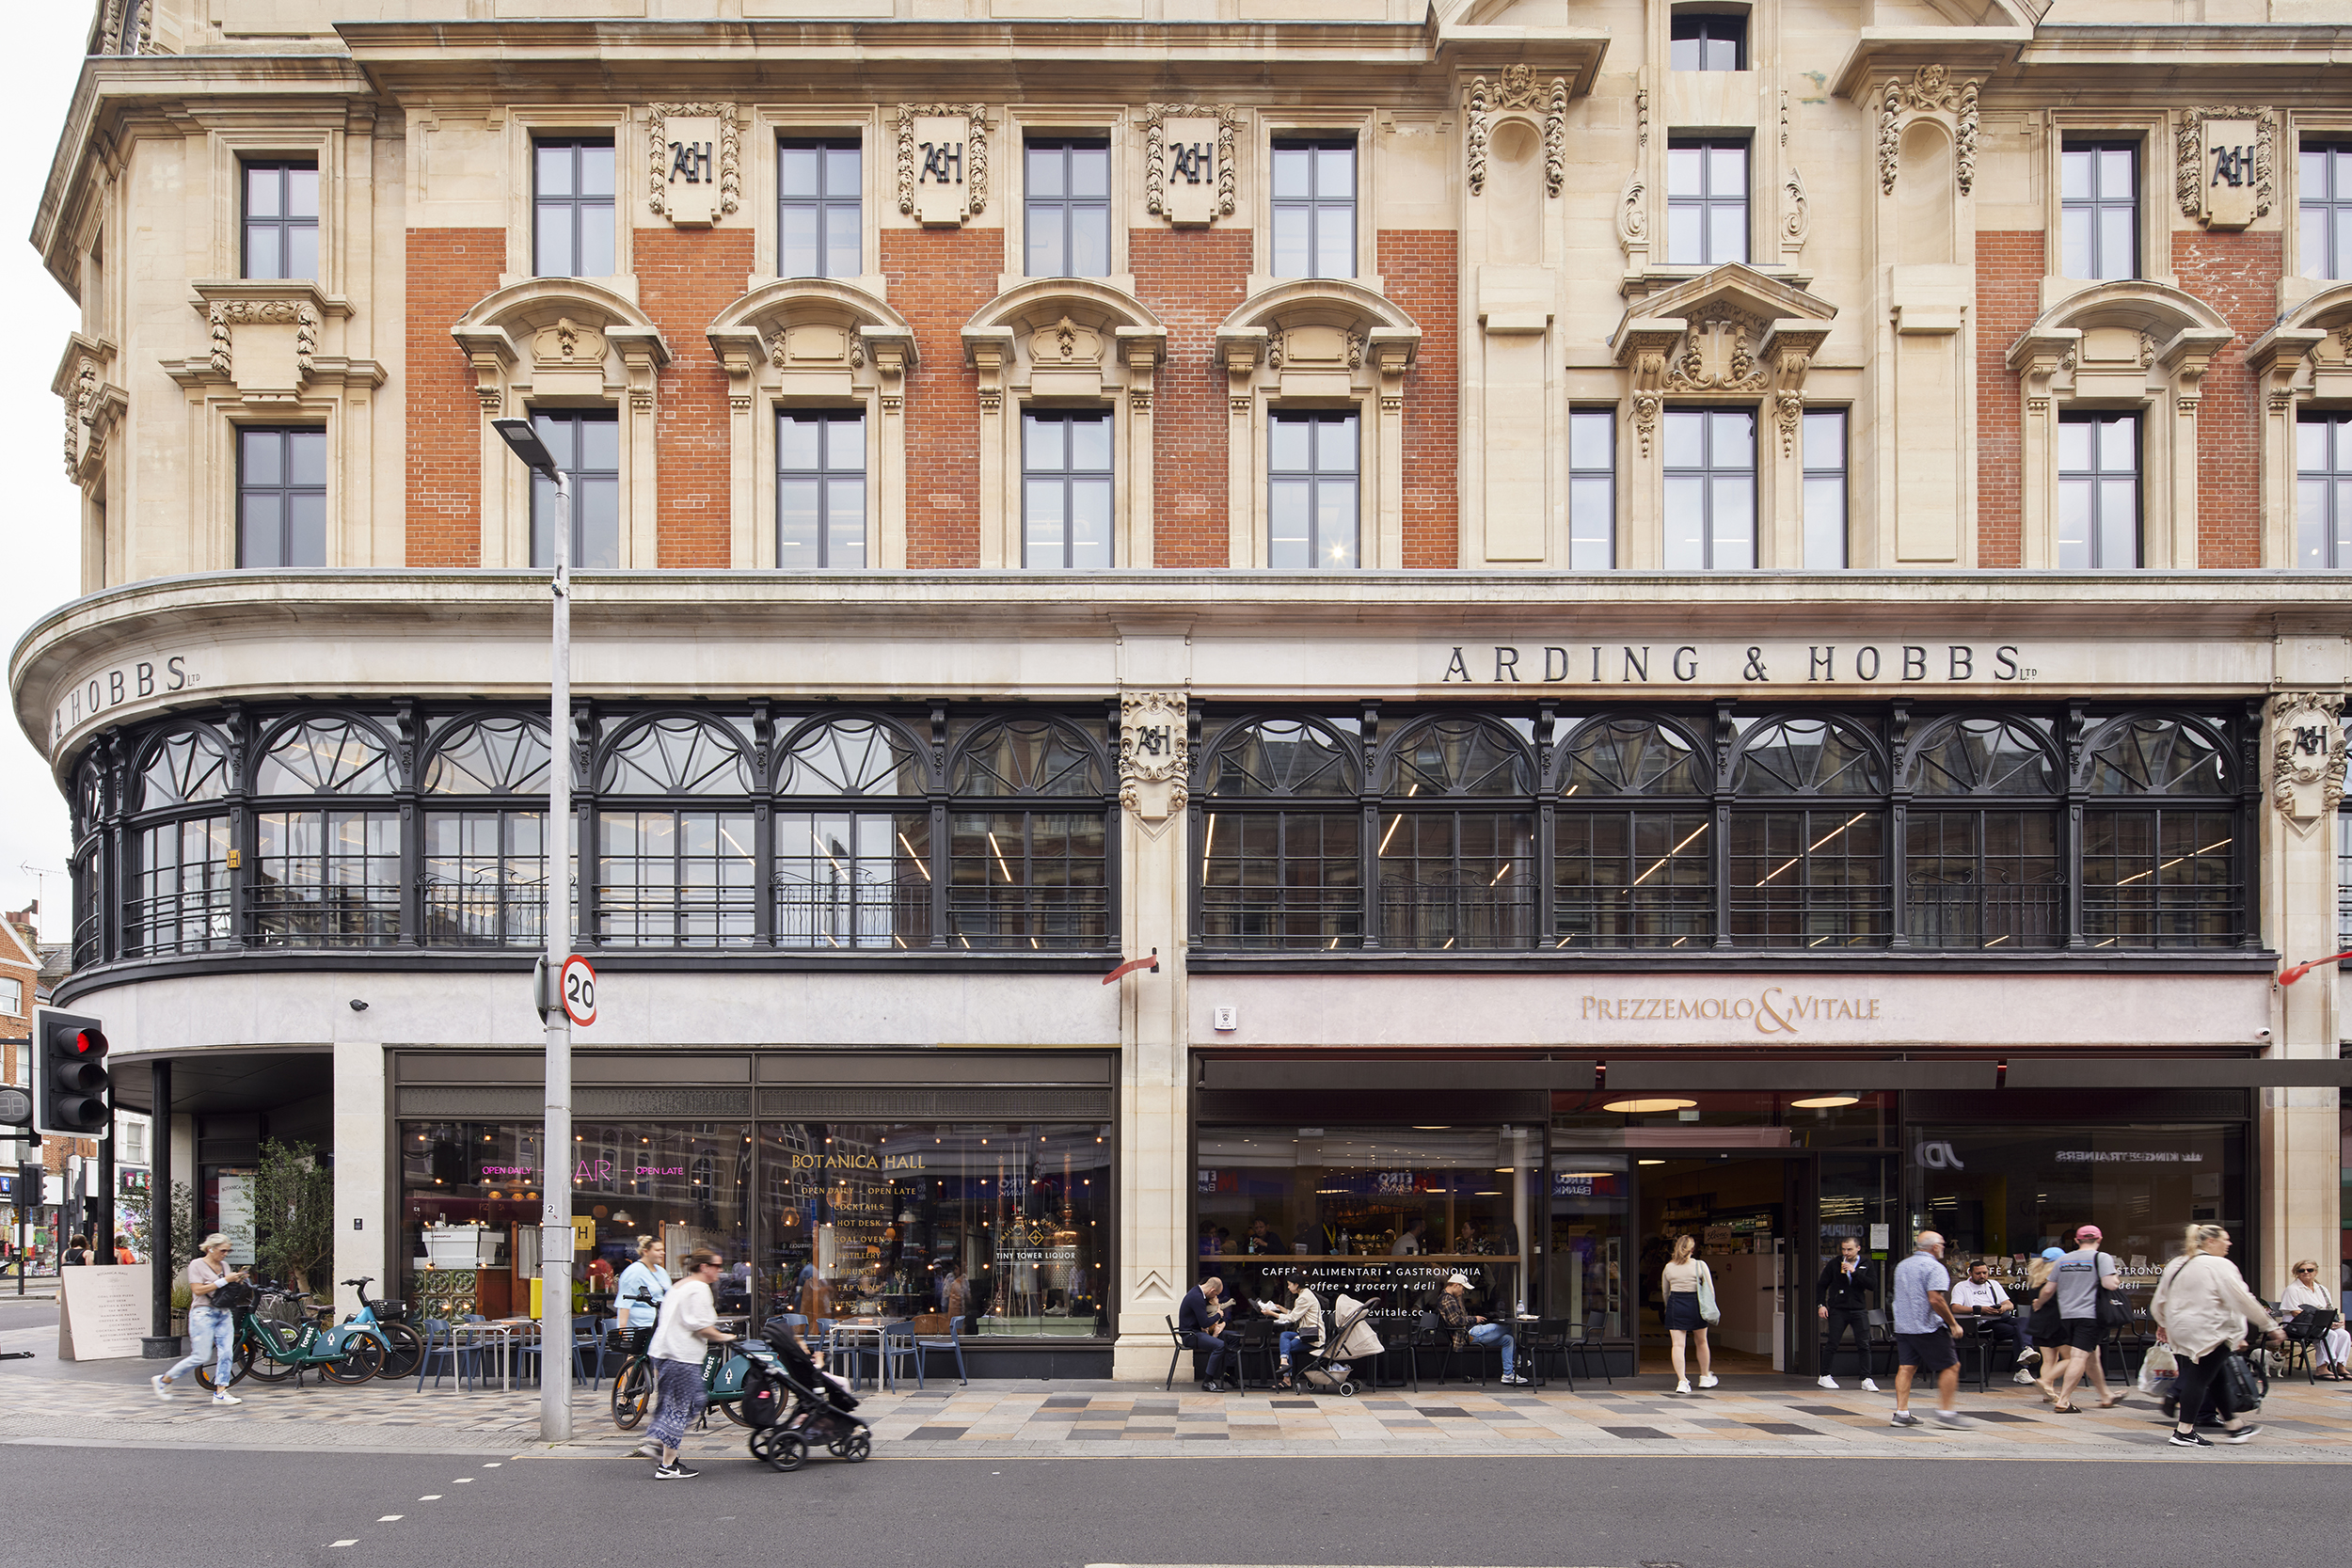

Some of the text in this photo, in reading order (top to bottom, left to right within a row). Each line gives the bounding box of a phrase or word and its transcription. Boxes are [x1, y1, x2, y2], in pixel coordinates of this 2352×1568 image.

[1442, 645, 1699, 683] ARDING
[1742, 645, 1769, 682] &
[1807, 645, 2019, 682] HOBBS
[71, 656, 185, 726] HOBBS
[567, 974, 595, 1008] 20
[1581, 987, 1880, 1034] PREZZEMOLO & VITALE
[482, 1166, 532, 1175] OPEN DAILY
[573, 1160, 611, 1181] AR
[635, 1166, 660, 1175] OPEN
[792, 1154, 925, 1169] BOTANICA HALL
[548, 1205, 554, 1213] 2
[1311, 1267, 1381, 1276] ALIMENTARI
[1396, 1267, 1481, 1276] GASTRONOMIA
[1355, 1283, 1398, 1292] grocery
[1413, 1280, 1436, 1291] deli
[2118, 1280, 2140, 1290] deli
[300, 1326, 314, 1348] forest
[701, 1355, 715, 1382] forest
